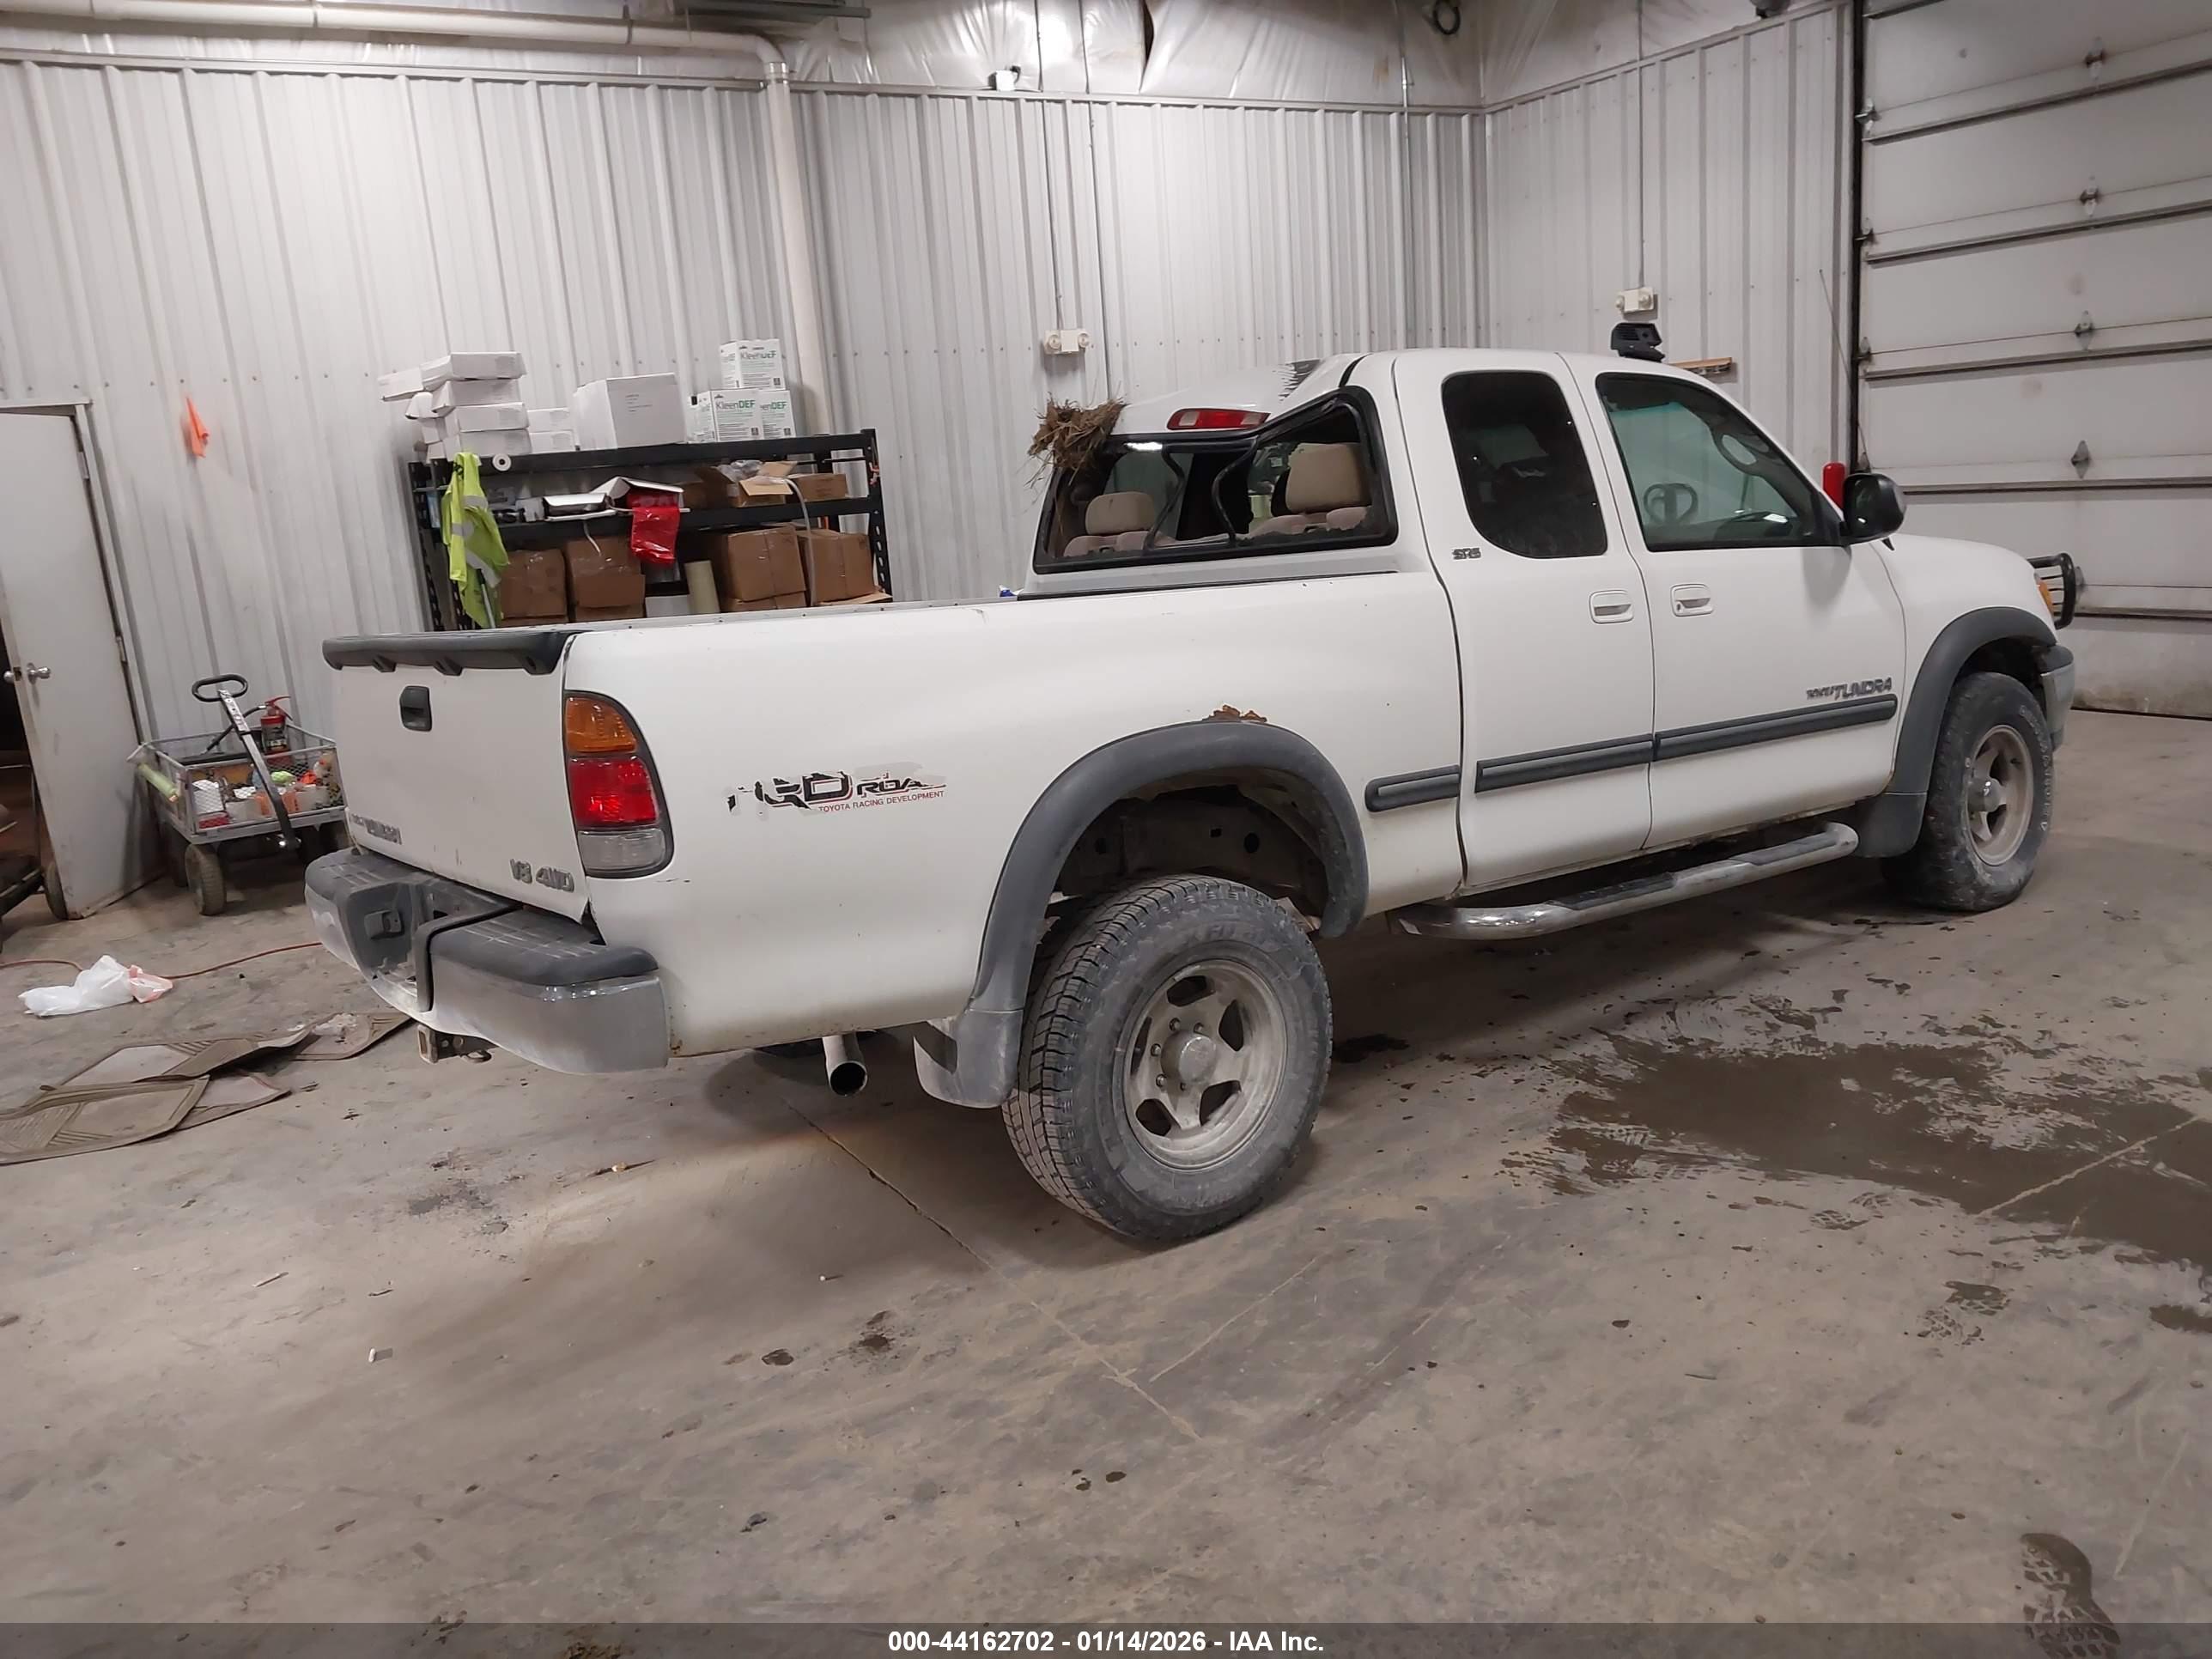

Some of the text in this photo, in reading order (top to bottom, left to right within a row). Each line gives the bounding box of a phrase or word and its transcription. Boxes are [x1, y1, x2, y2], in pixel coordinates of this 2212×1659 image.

[715, 399, 756, 410] KleenDEF
[817, 790, 945, 813] TOYOTA RACING DEVELOPMENT
[510, 858, 532, 884] V8
